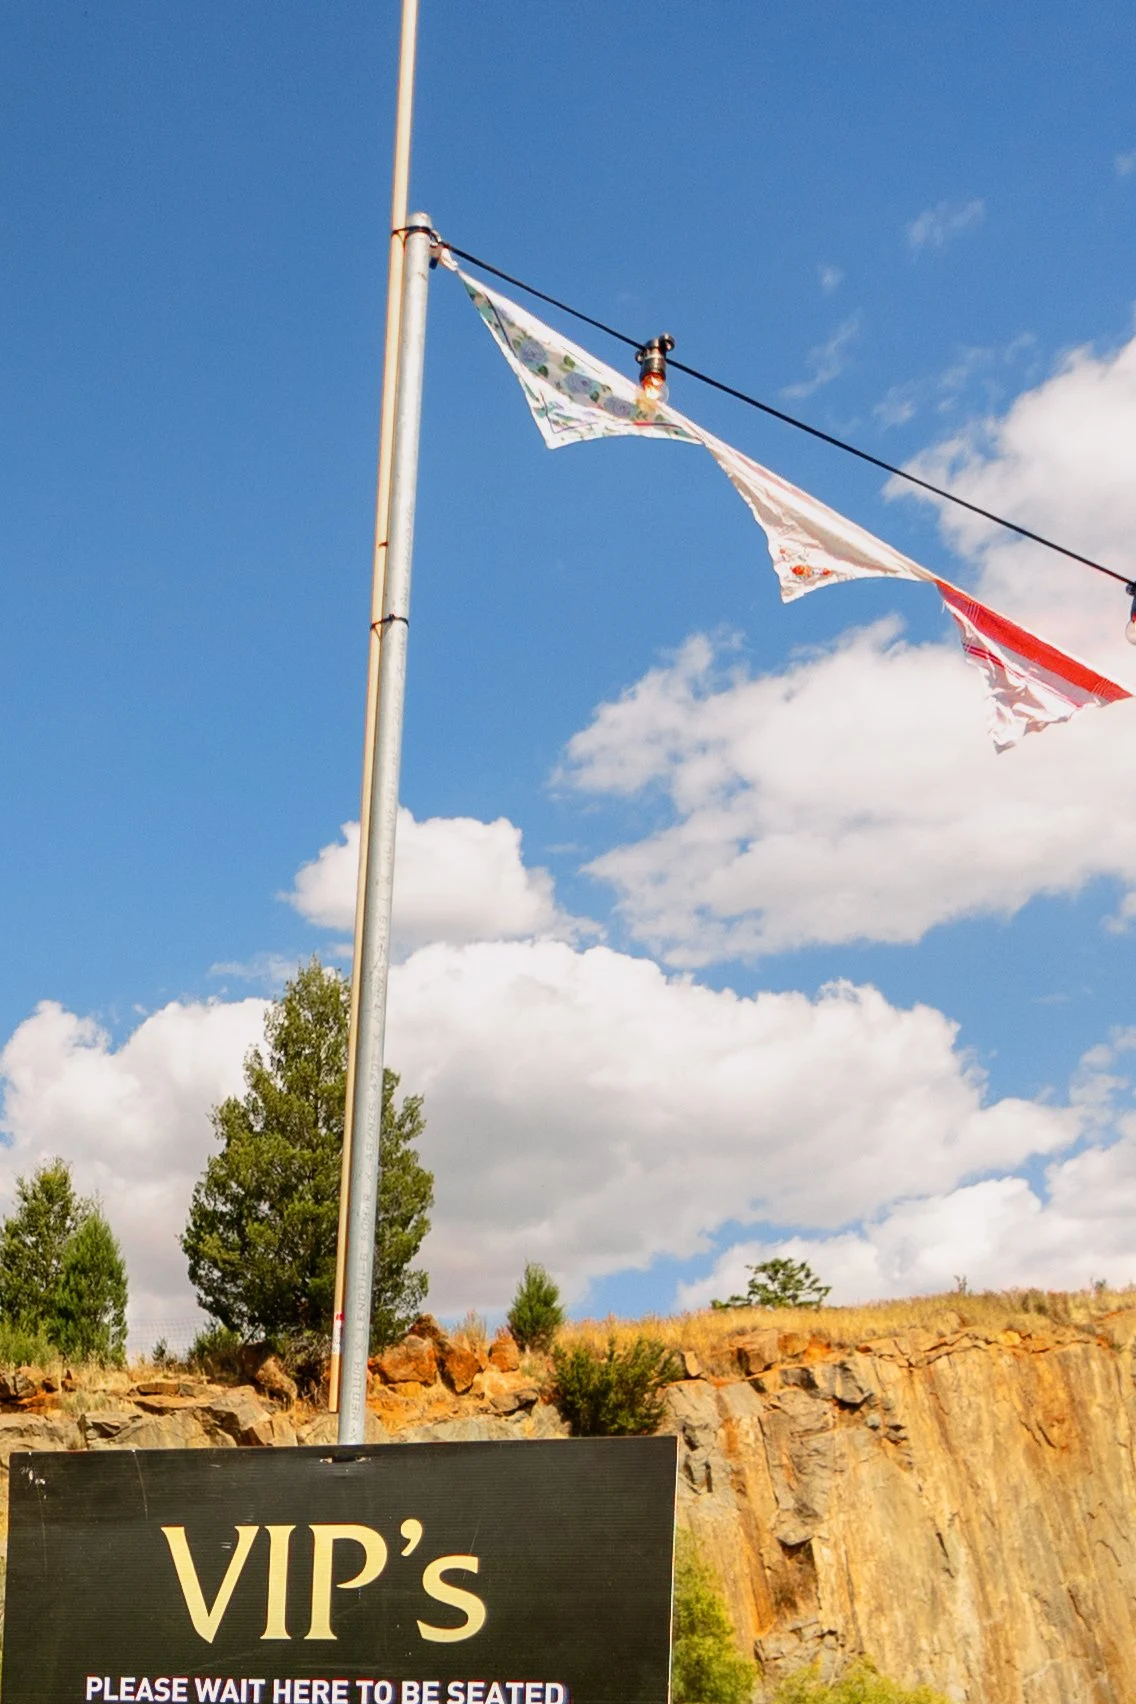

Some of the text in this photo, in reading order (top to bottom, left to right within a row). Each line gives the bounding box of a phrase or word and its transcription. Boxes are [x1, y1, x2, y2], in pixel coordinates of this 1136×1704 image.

[161, 1518, 487, 1644] VIP's
[85, 1675, 189, 1703] PLEASE
[194, 1677, 266, 1704] WAIT
